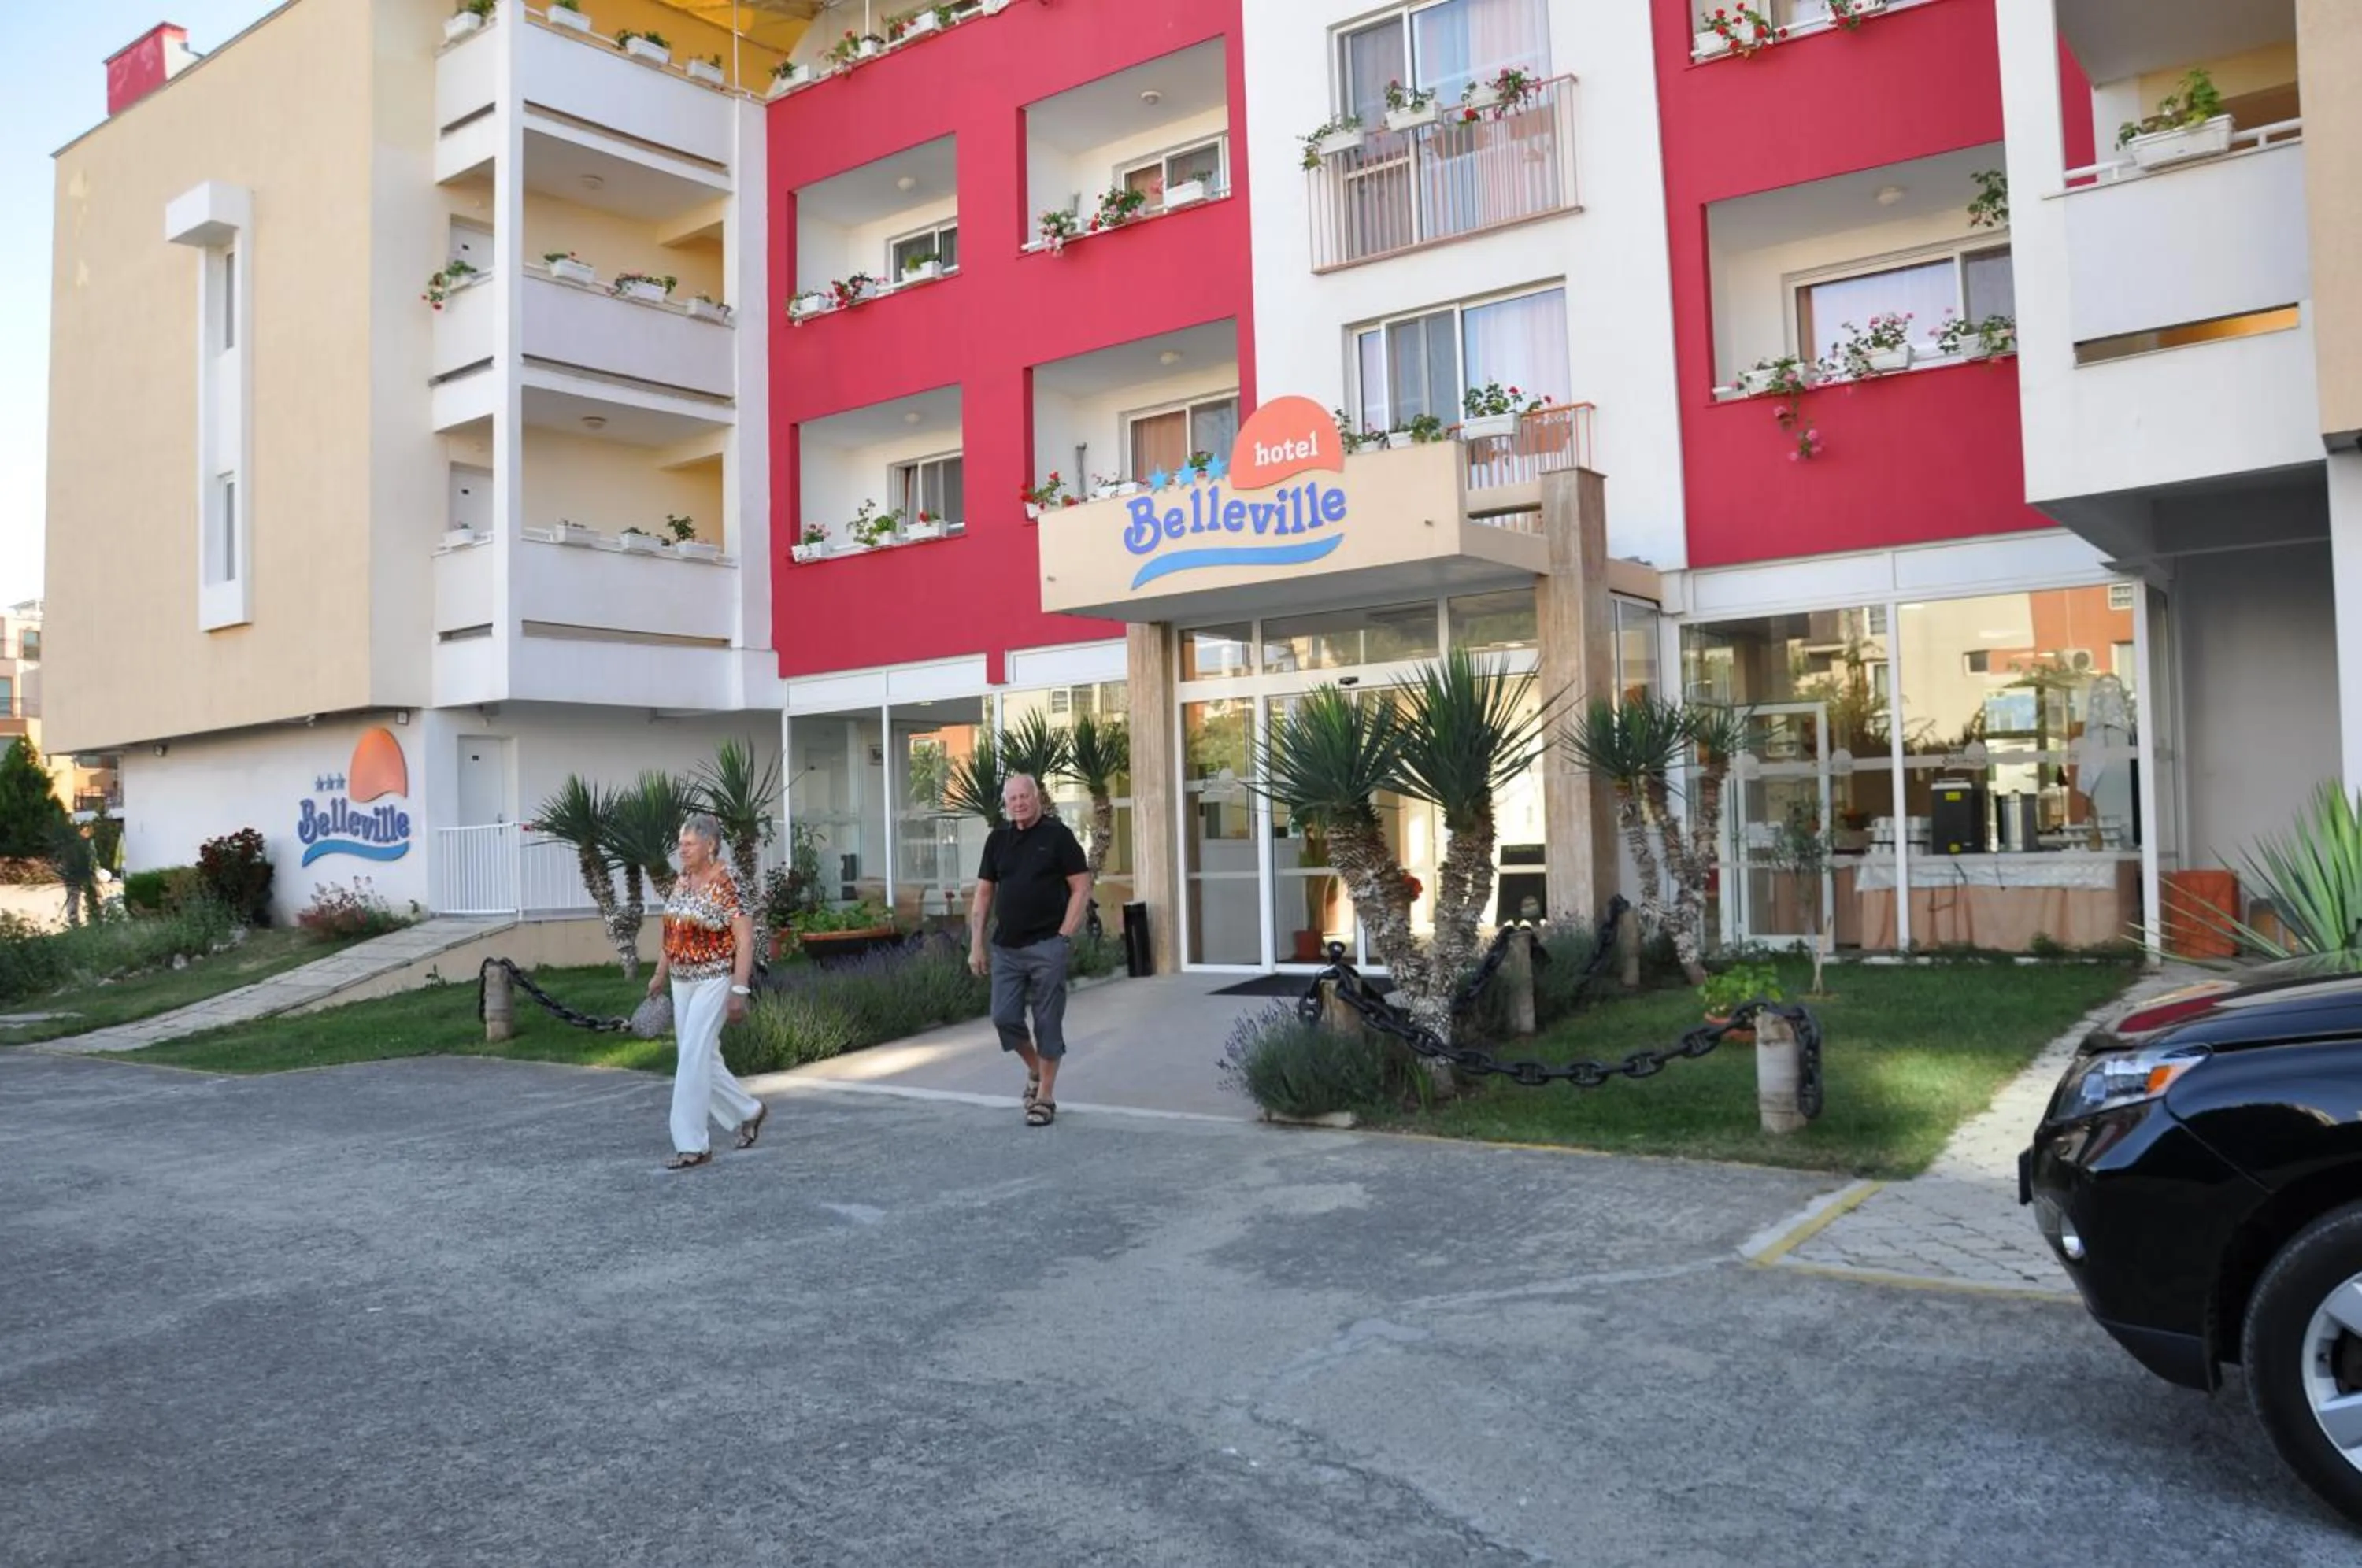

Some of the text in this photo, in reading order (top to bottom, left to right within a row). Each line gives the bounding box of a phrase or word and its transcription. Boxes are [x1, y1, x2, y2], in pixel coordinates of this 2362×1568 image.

[1253, 431, 1320, 467] hotel
[1124, 481, 1347, 555] Belleville
[298, 797, 411, 845] Belleville
